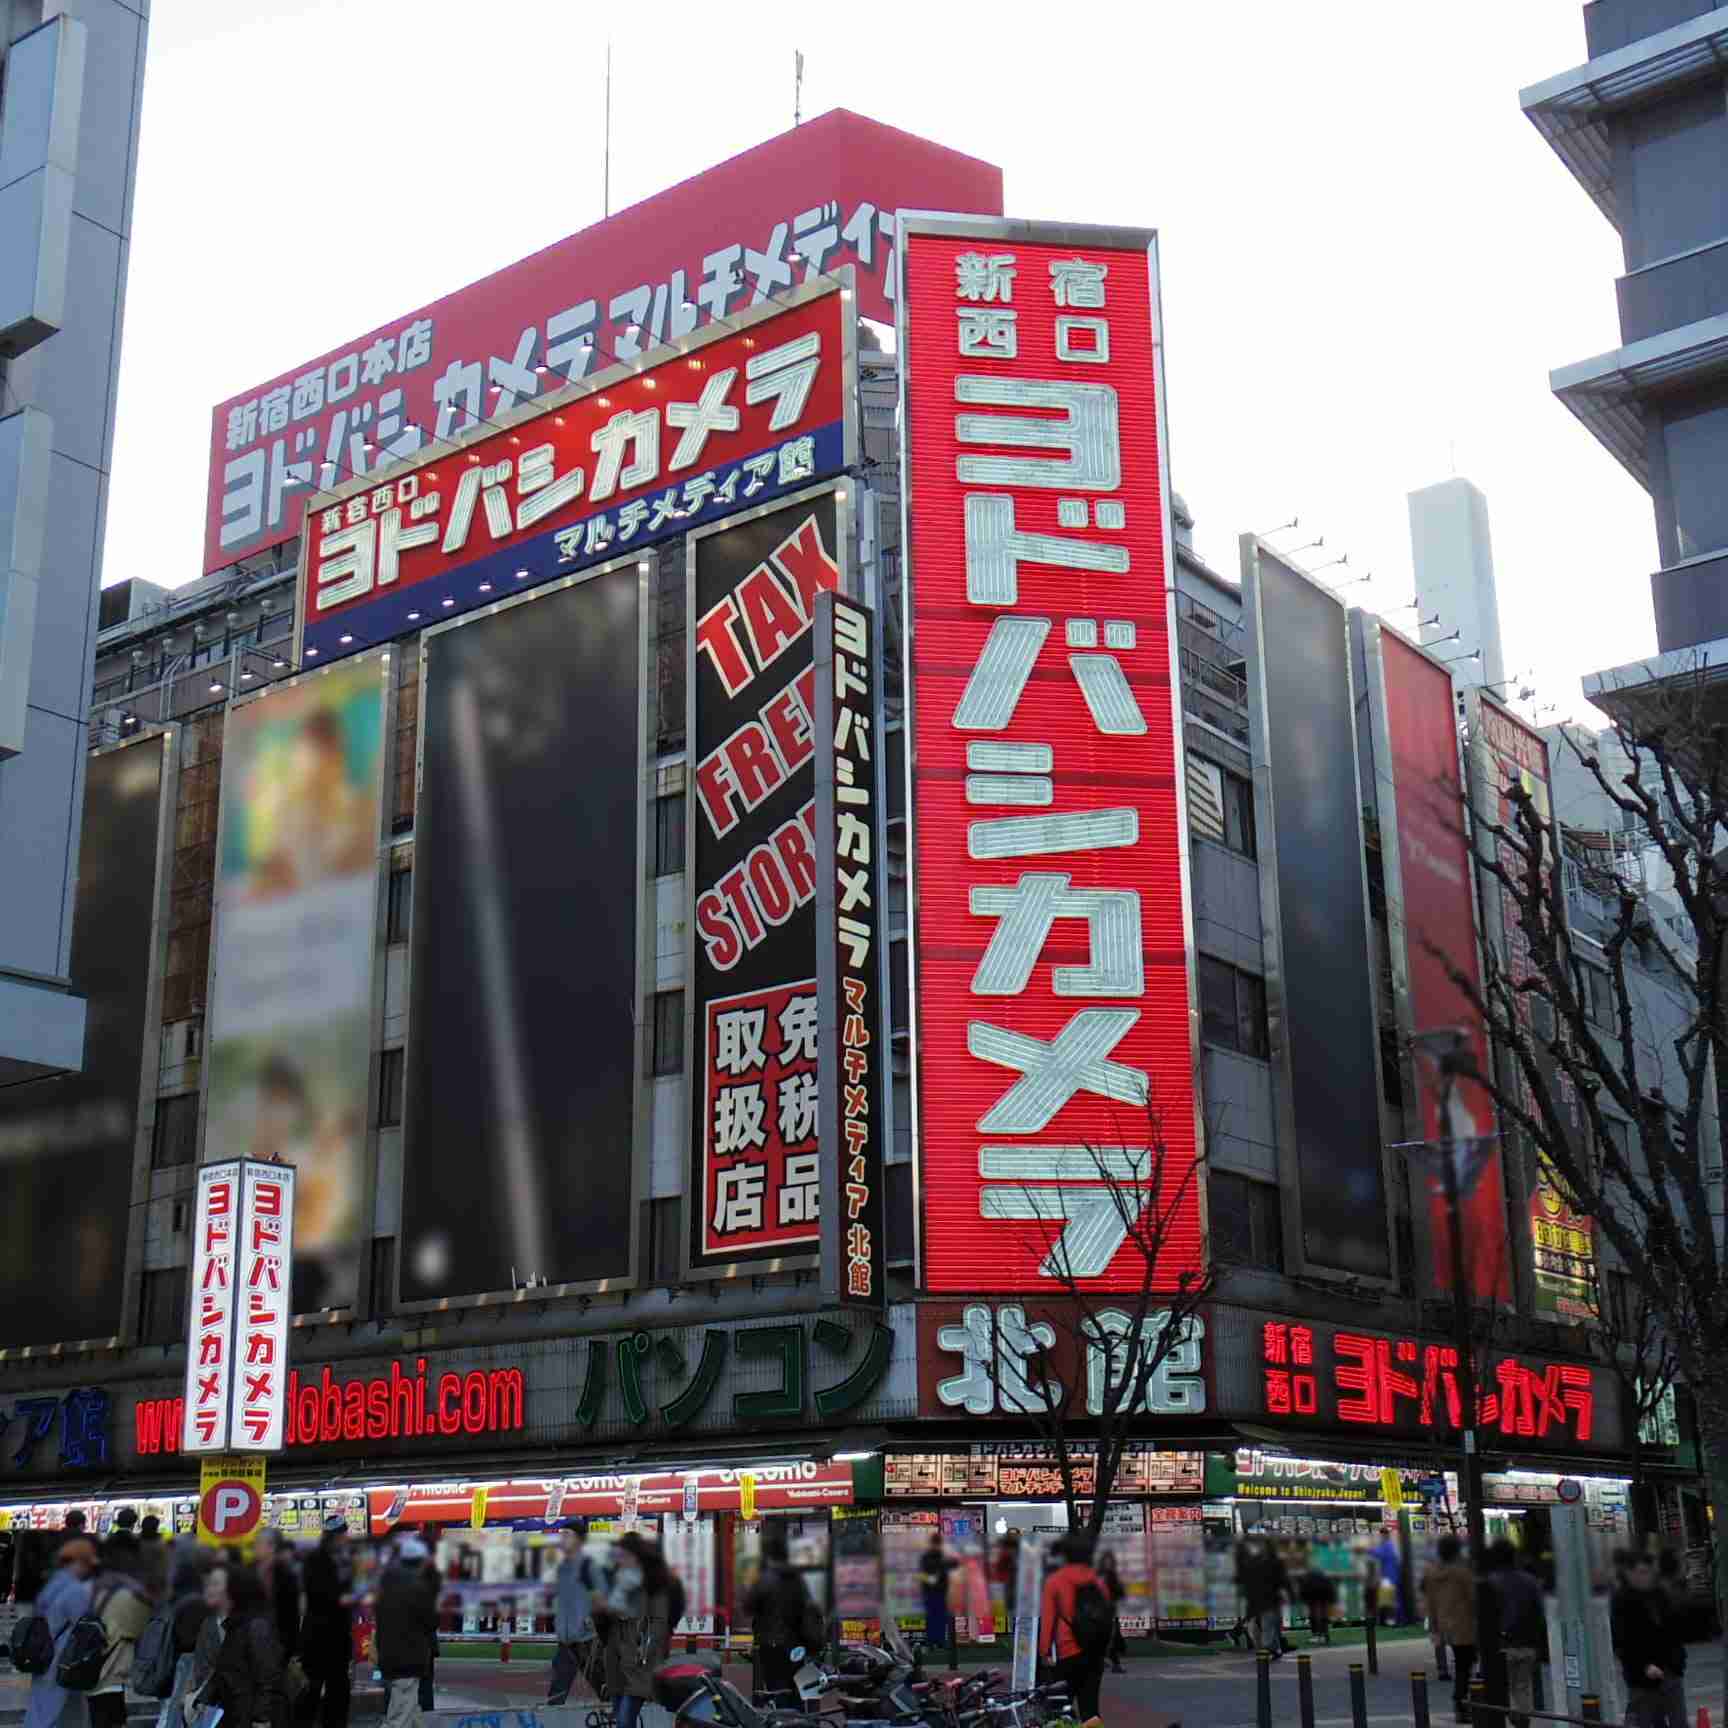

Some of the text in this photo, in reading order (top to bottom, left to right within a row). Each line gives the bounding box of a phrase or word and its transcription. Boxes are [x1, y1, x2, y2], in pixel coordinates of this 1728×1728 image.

[226, 319, 432, 450] 新宿西口本店
[316, 330, 821, 611] ヨドバシカメラ
[321, 474, 418, 534] 新宿西口
[554, 435, 815, 563] マルチメディア館
[695, 512, 840, 700] TAX
[834, 602, 872, 969] ヨドバシカメラ
[950, 374, 1150, 1279] ヨドバシカメラ
[712, 1007, 766, 1234] 取扱店
[194, 1182, 232, 1446] ヨドバシカメラ
[242, 1181, 283, 1444] ヨドバシカメラ
[575, 1319, 894, 1426] パソコン
[937, 1303, 1206, 1415] 北館
[213, 1488, 249, 1533] P
